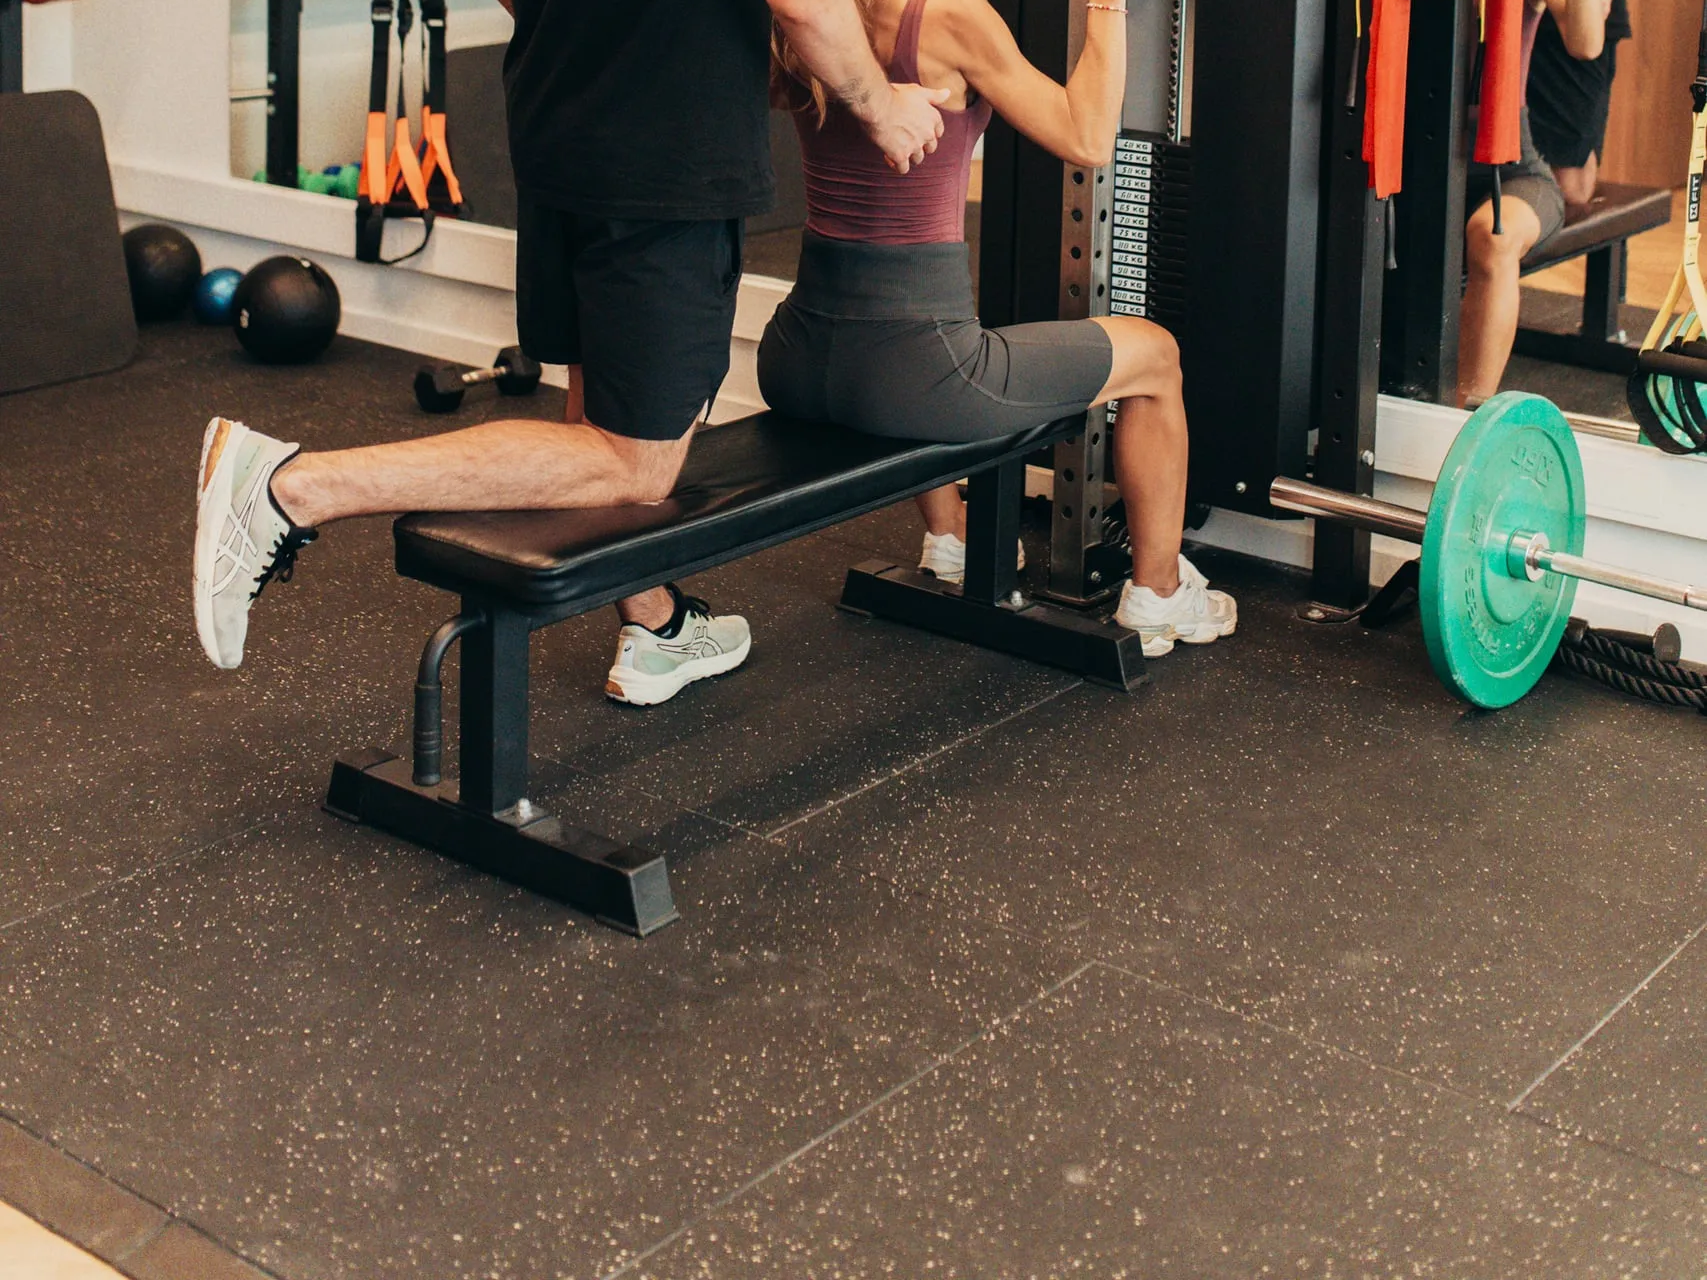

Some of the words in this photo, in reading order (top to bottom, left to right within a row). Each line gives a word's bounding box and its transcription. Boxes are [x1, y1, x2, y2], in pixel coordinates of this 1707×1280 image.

[1135, 168, 1147, 176] KG
[1691, 175, 1702, 202] FIT
[1134, 193, 1145, 201] KG
[1130, 281, 1142, 289] KG
[1129, 306, 1141, 314] KG
